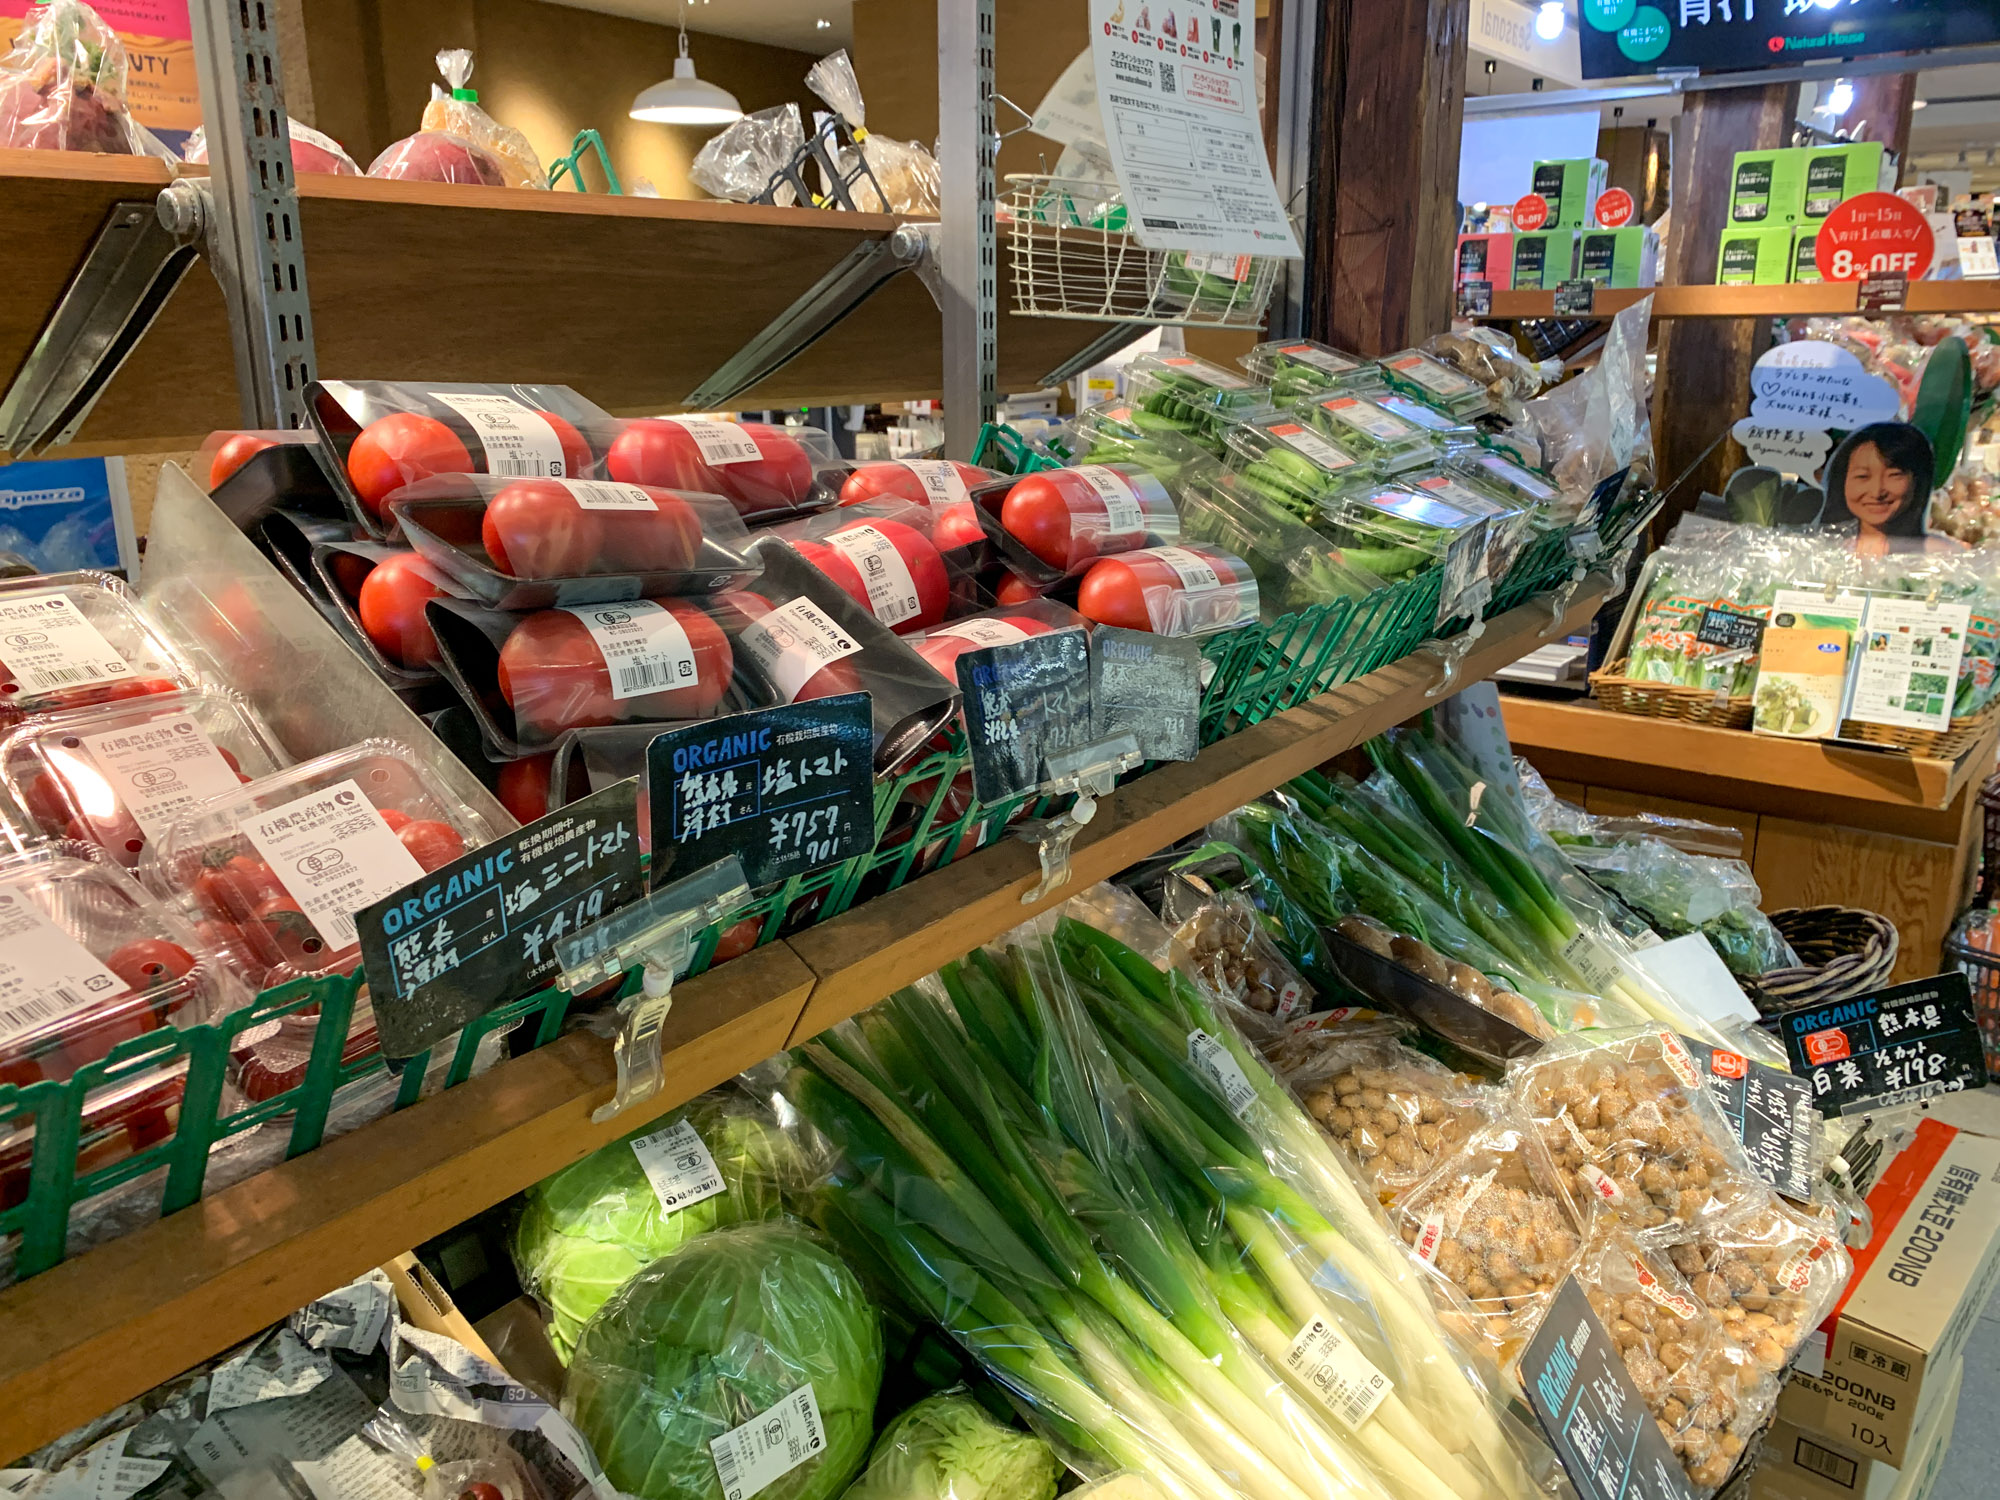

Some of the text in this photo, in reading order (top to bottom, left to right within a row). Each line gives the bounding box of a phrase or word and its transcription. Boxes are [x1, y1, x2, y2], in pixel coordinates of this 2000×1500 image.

[1785, 31, 1865, 50] Natural House
[631, 651, 668, 666] 塩トマト
[100, 727, 173, 754] 有機農産物
[673, 727, 771, 773] ORGANIC
[760, 747, 848, 796] 塩トマト
[259, 800, 335, 838] 有機農産物
[739, 804, 753, 815] さん
[266, 832, 294, 845] Organic
[517, 817, 574, 851] 転換期間中
[520, 819, 597, 865] 有機栽培農産物
[806, 836, 840, 864] 701
[323, 852, 341, 863] JAS
[505, 821, 631, 917] 塩ミニトマト
[382, 847, 515, 936] ORGANIC
[393, 918, 454, 968] 熊本
[481, 931, 497, 945] さん
[1793, 998, 1879, 1034] ORGANIC
[1877, 1004, 1942, 1038] 熊本県
[1894, 1041, 1927, 1060] カット
[1812, 1059, 1864, 1097] 白菜
[1884, 1053, 1947, 1091] ¥198
[677, 1178, 718, 1200] 有機農産物
[1287, 1331, 1317, 1367] 有機農産物
[1852, 1345, 1907, 1378] 要冷蔵
[1537, 1335, 1578, 1419] ORGANIC
[1790, 1374, 1885, 1421] 大豆もやし 200g
[798, 1394, 817, 1438] 有機農産物
[1851, 1422, 1893, 1456] 10入
